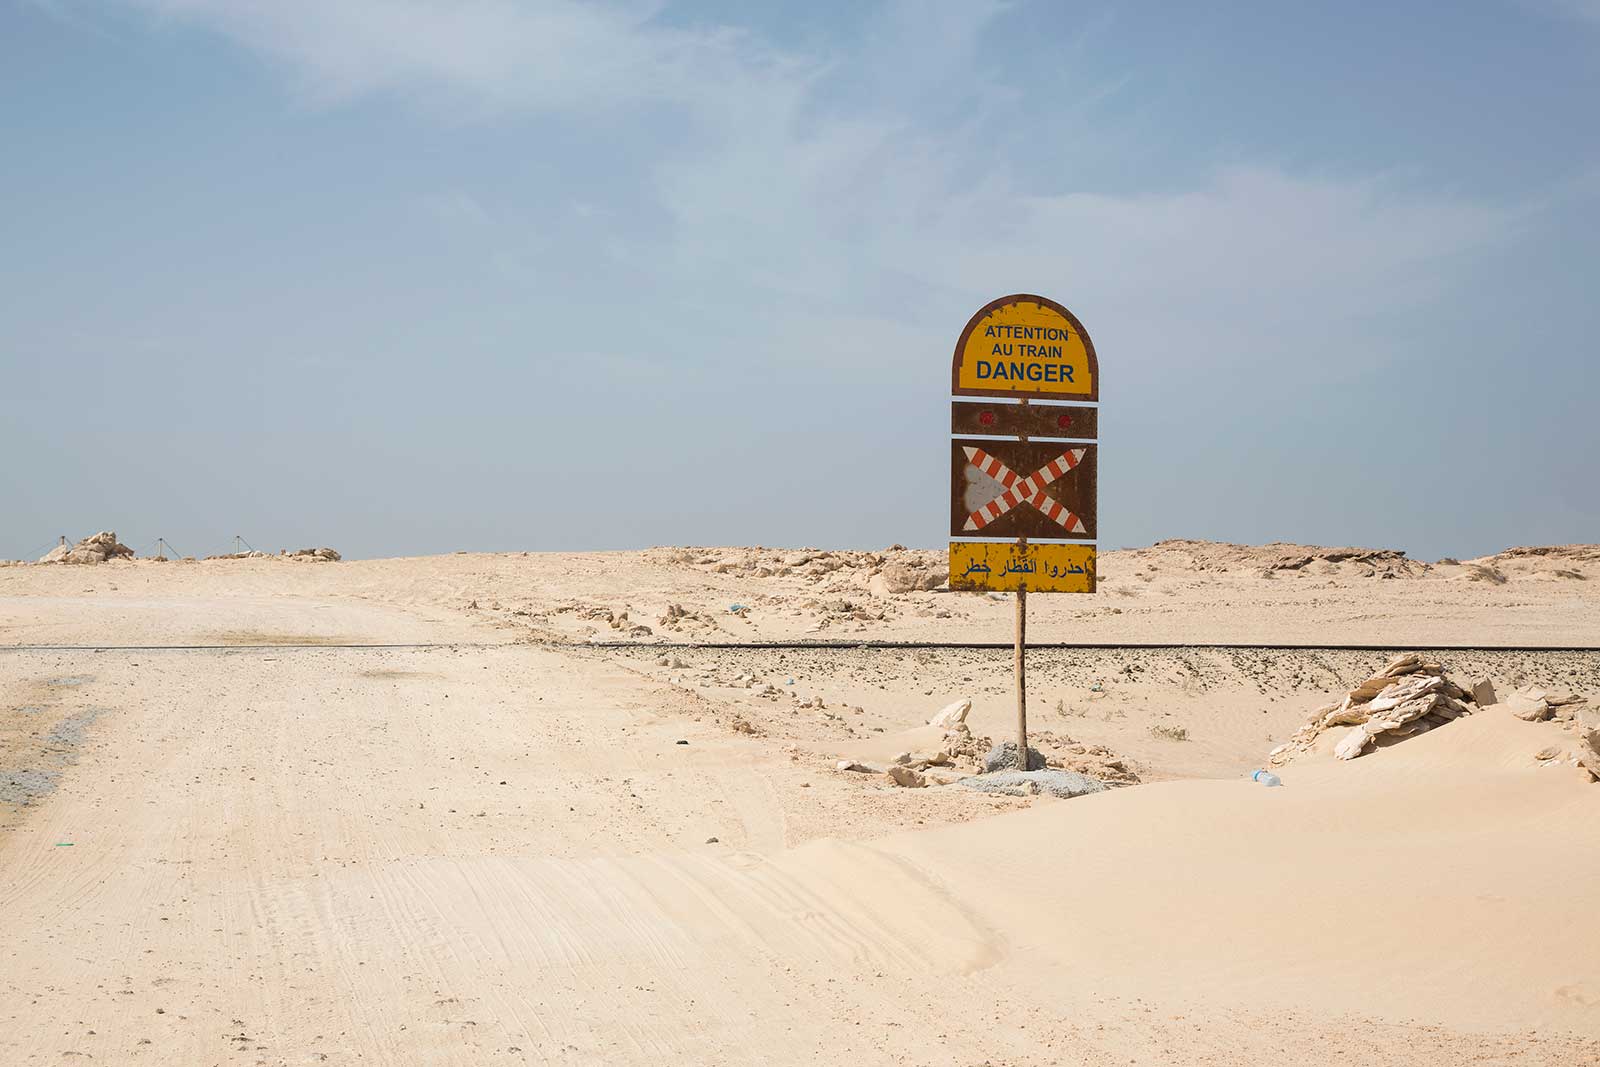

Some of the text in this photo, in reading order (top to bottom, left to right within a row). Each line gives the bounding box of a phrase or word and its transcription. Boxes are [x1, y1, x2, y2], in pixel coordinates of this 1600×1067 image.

[985, 325, 1069, 341] ATTENTION
[992, 344, 1062, 358] AU TRAIN
[976, 360, 1074, 383] DANGER
[960, 557, 991, 577] خطر
